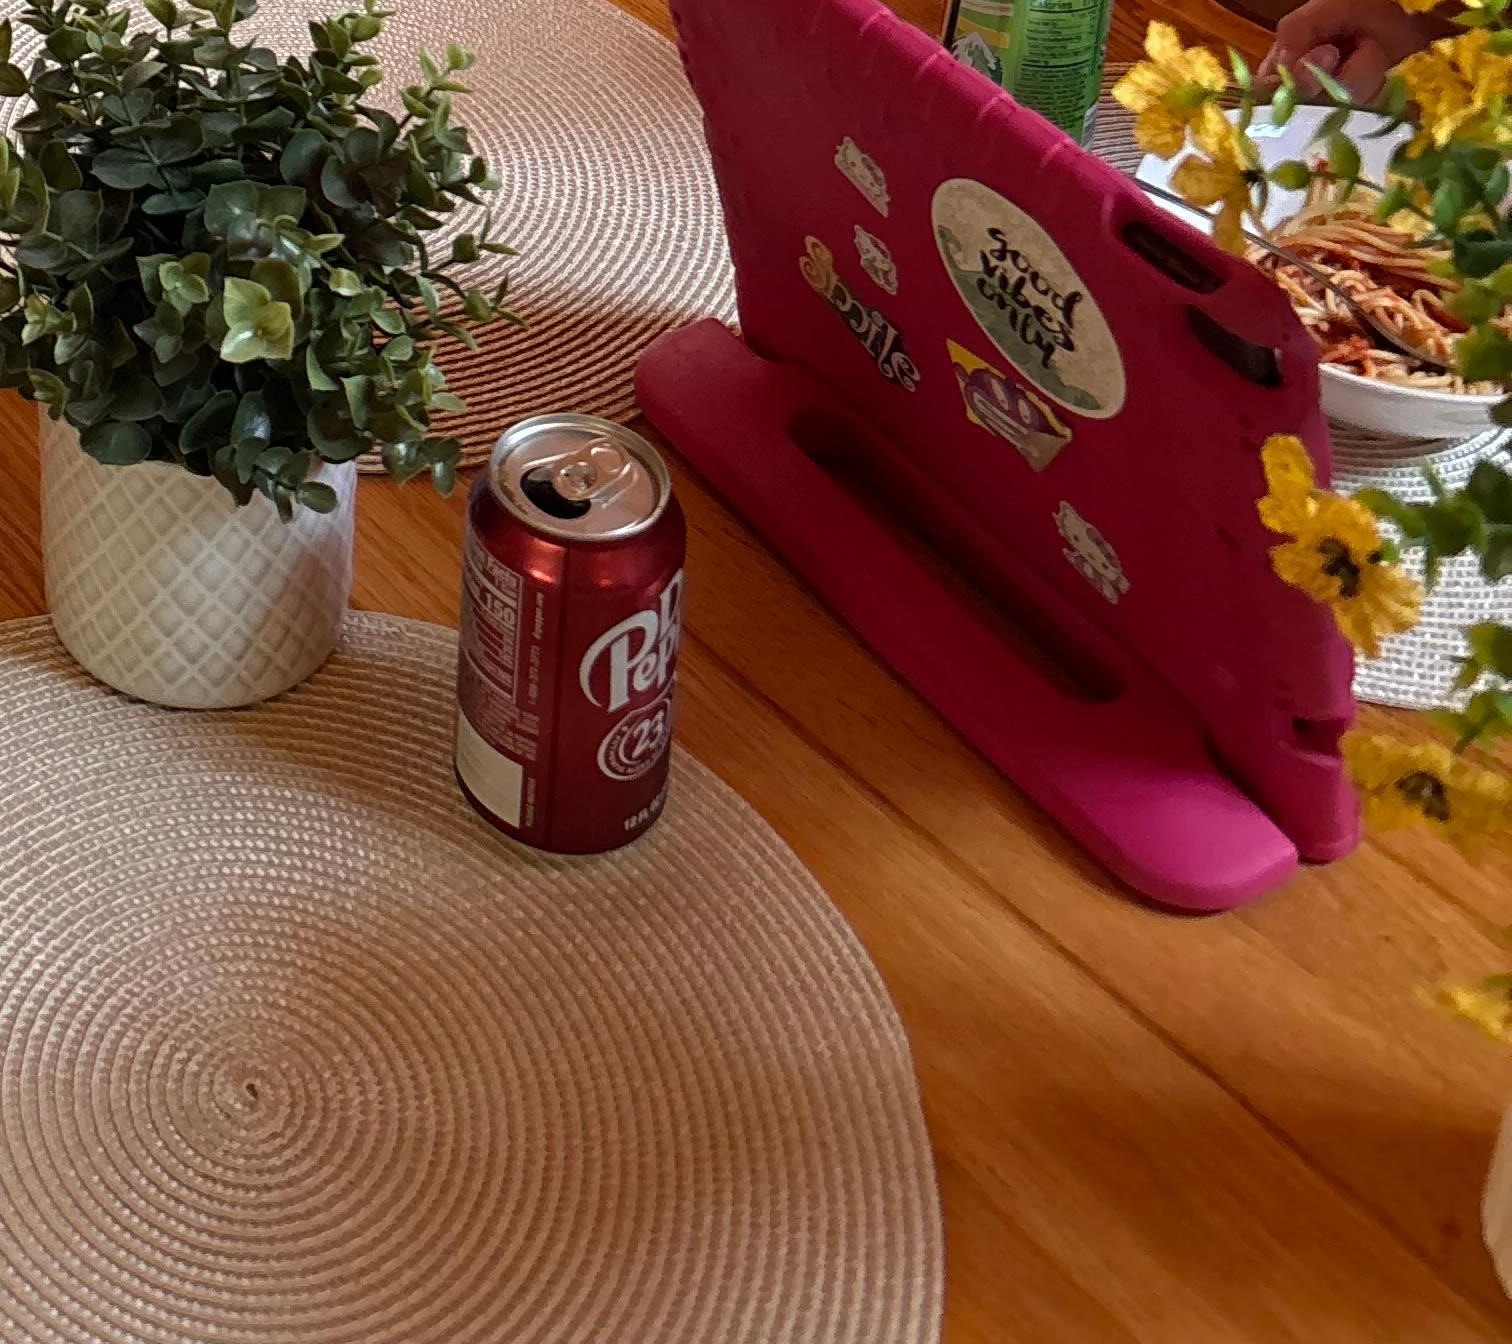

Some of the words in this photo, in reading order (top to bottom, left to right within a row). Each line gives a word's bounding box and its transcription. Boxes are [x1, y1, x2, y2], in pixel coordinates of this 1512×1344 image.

[798, 234, 922, 393] Smile
[976, 277, 1056, 370] only
[979, 250, 1076, 353] vibes
[987, 227, 1084, 329] good
[631, 709, 664, 760] 23
